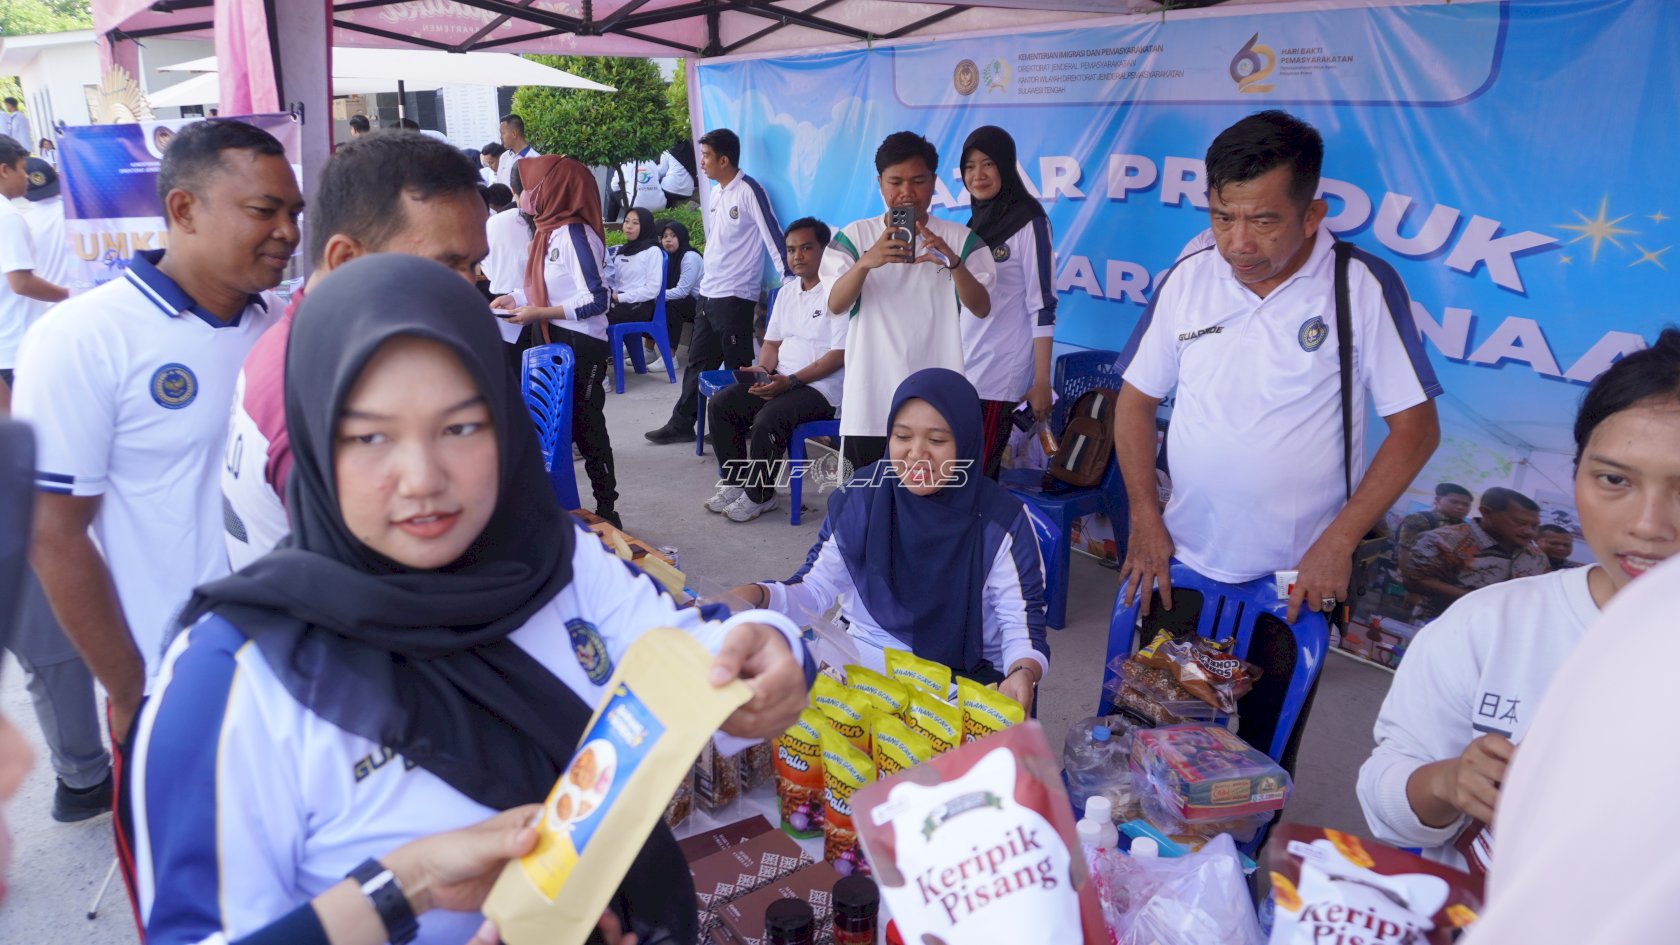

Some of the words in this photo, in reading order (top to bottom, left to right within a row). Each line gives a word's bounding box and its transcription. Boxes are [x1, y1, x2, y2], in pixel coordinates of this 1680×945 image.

[1018, 52, 1058, 60] KEMENTERIAN
[1059, 49, 1085, 59] IMIGRASI
[1086, 48, 1100, 57] DAN
[1101, 44, 1164, 56] PEMASYARAKATAN
[1280, 55, 1354, 63] PEMASYARAKATAN
[1018, 64, 1050, 72] DIREKTORAT
[1051, 62, 1079, 72] JENDERAL
[1080, 60, 1137, 70] PEMASYARAKATAN
[1018, 75, 1040, 84] KANTOR
[1063, 73, 1097, 82] DIREKTORAT
[1127, 69, 1184, 80] PEMASYARAKATAN
[1044, 85, 1066, 94] TENGAH
[1107, 154, 1560, 293] PRDUK
[779, 746, 809, 771] Palu
[916, 824, 1043, 905] Keripik
[940, 856, 1058, 925] Pisang
